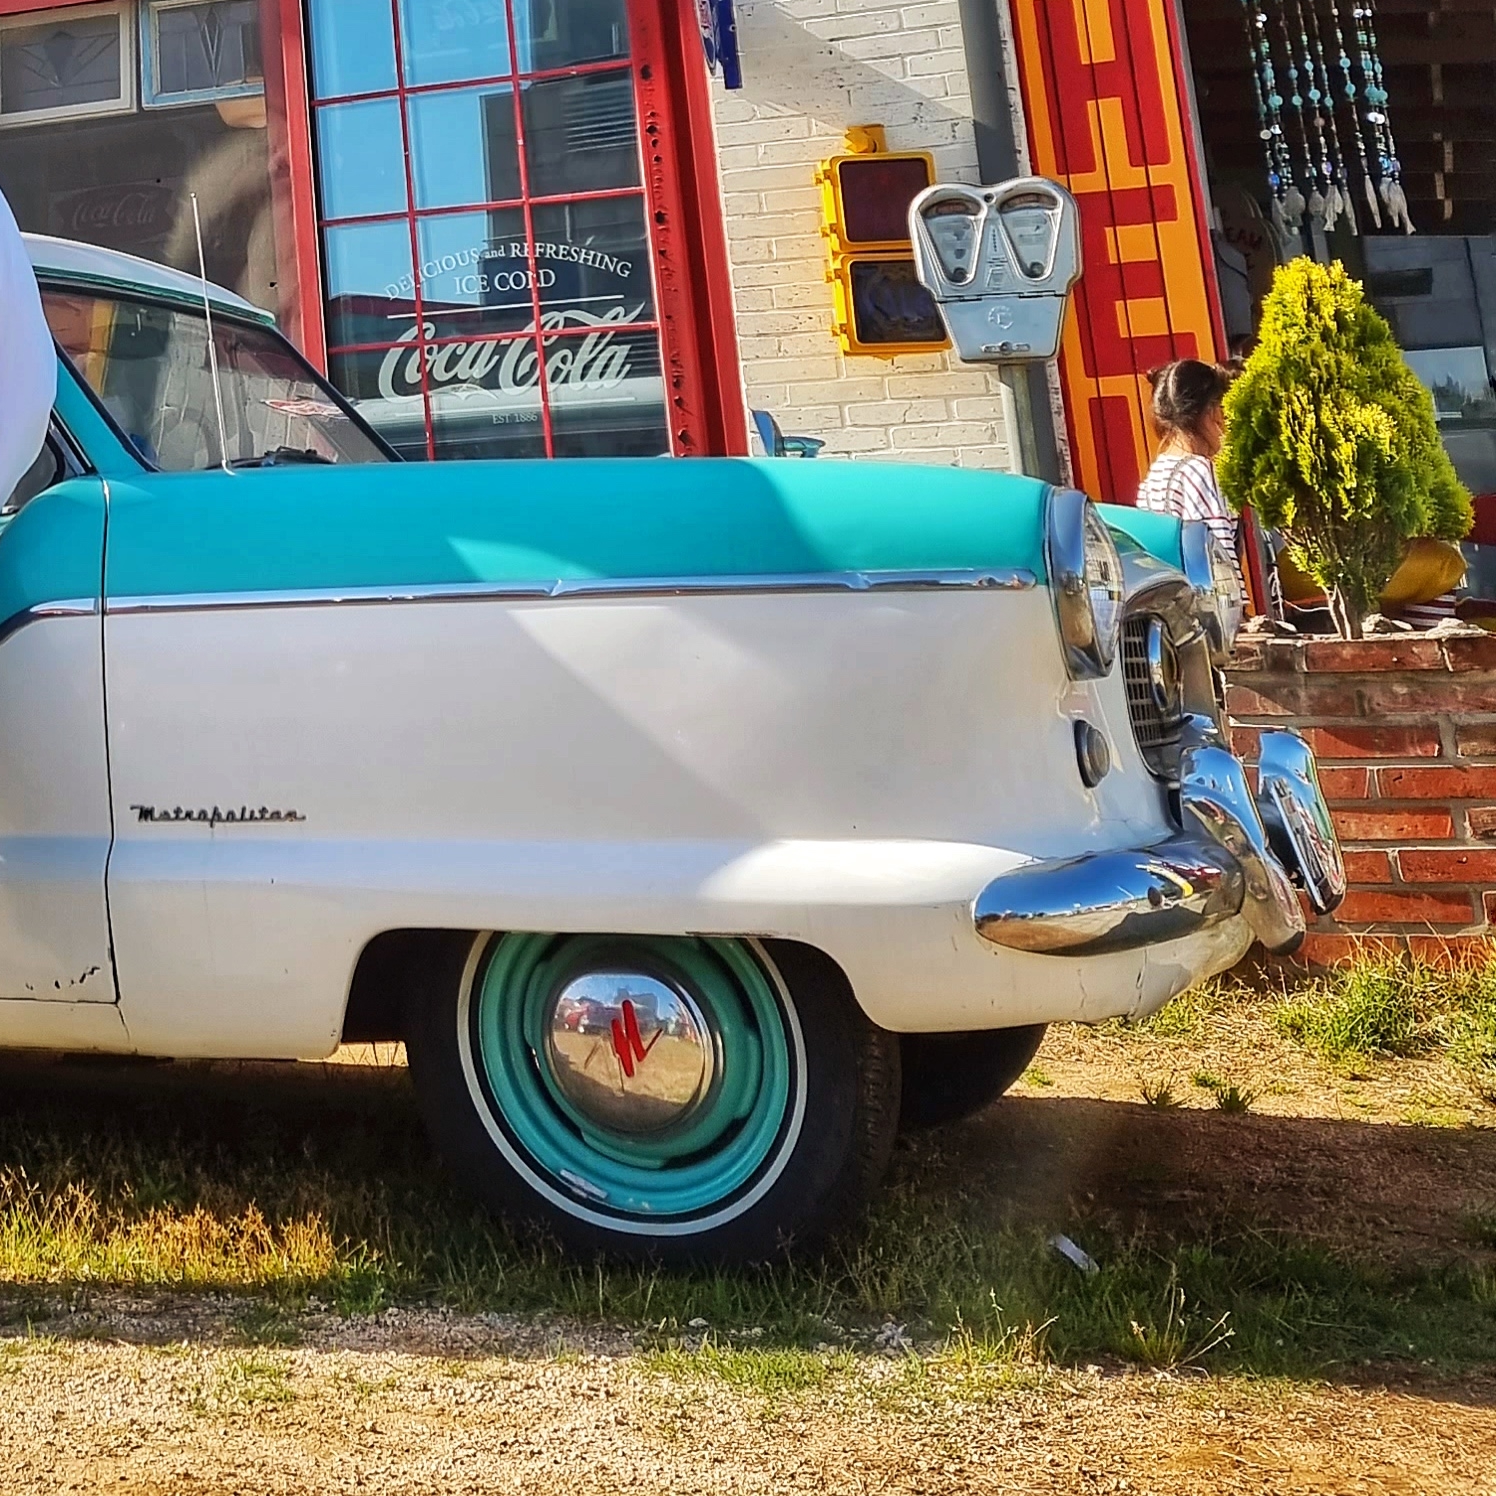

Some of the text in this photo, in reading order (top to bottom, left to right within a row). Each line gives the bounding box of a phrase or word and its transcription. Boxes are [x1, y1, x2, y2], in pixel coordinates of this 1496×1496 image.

[384, 247, 481, 301] DELICIOUS
[485, 245, 506, 259] and
[454, 269, 556, 295] ICE COLD
[378, 301, 645, 404] Coca-Cola
[130, 805, 306, 828] Metropolitan
